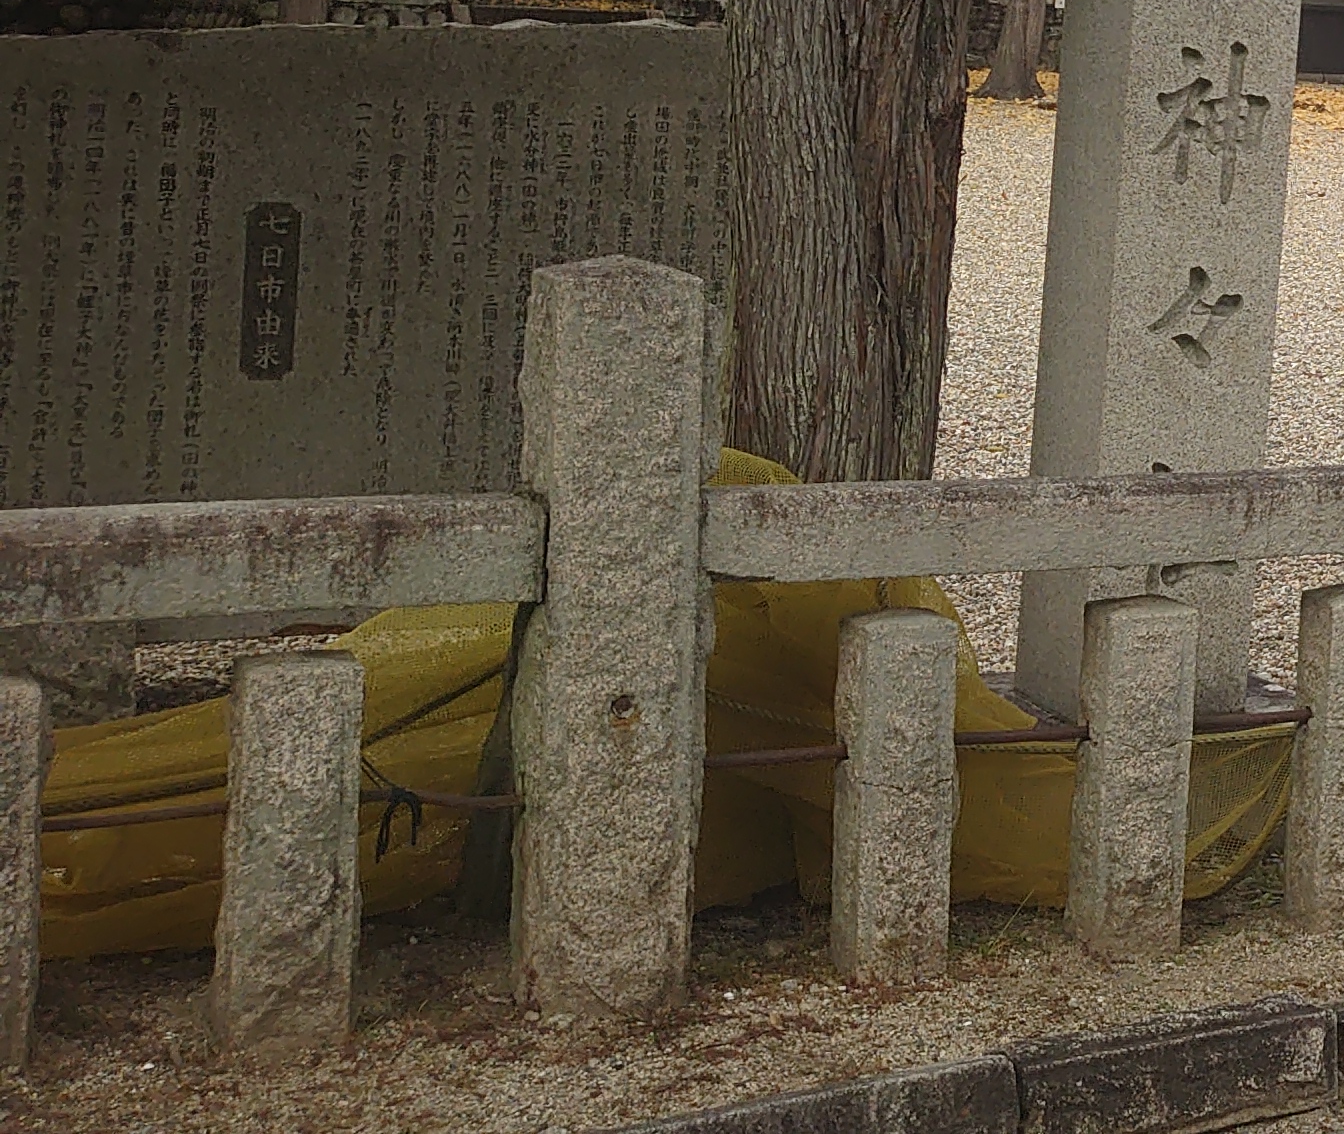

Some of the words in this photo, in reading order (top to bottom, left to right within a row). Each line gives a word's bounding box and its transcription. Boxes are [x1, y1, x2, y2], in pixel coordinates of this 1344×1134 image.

[254, 214, 292, 369] 七日市由来
